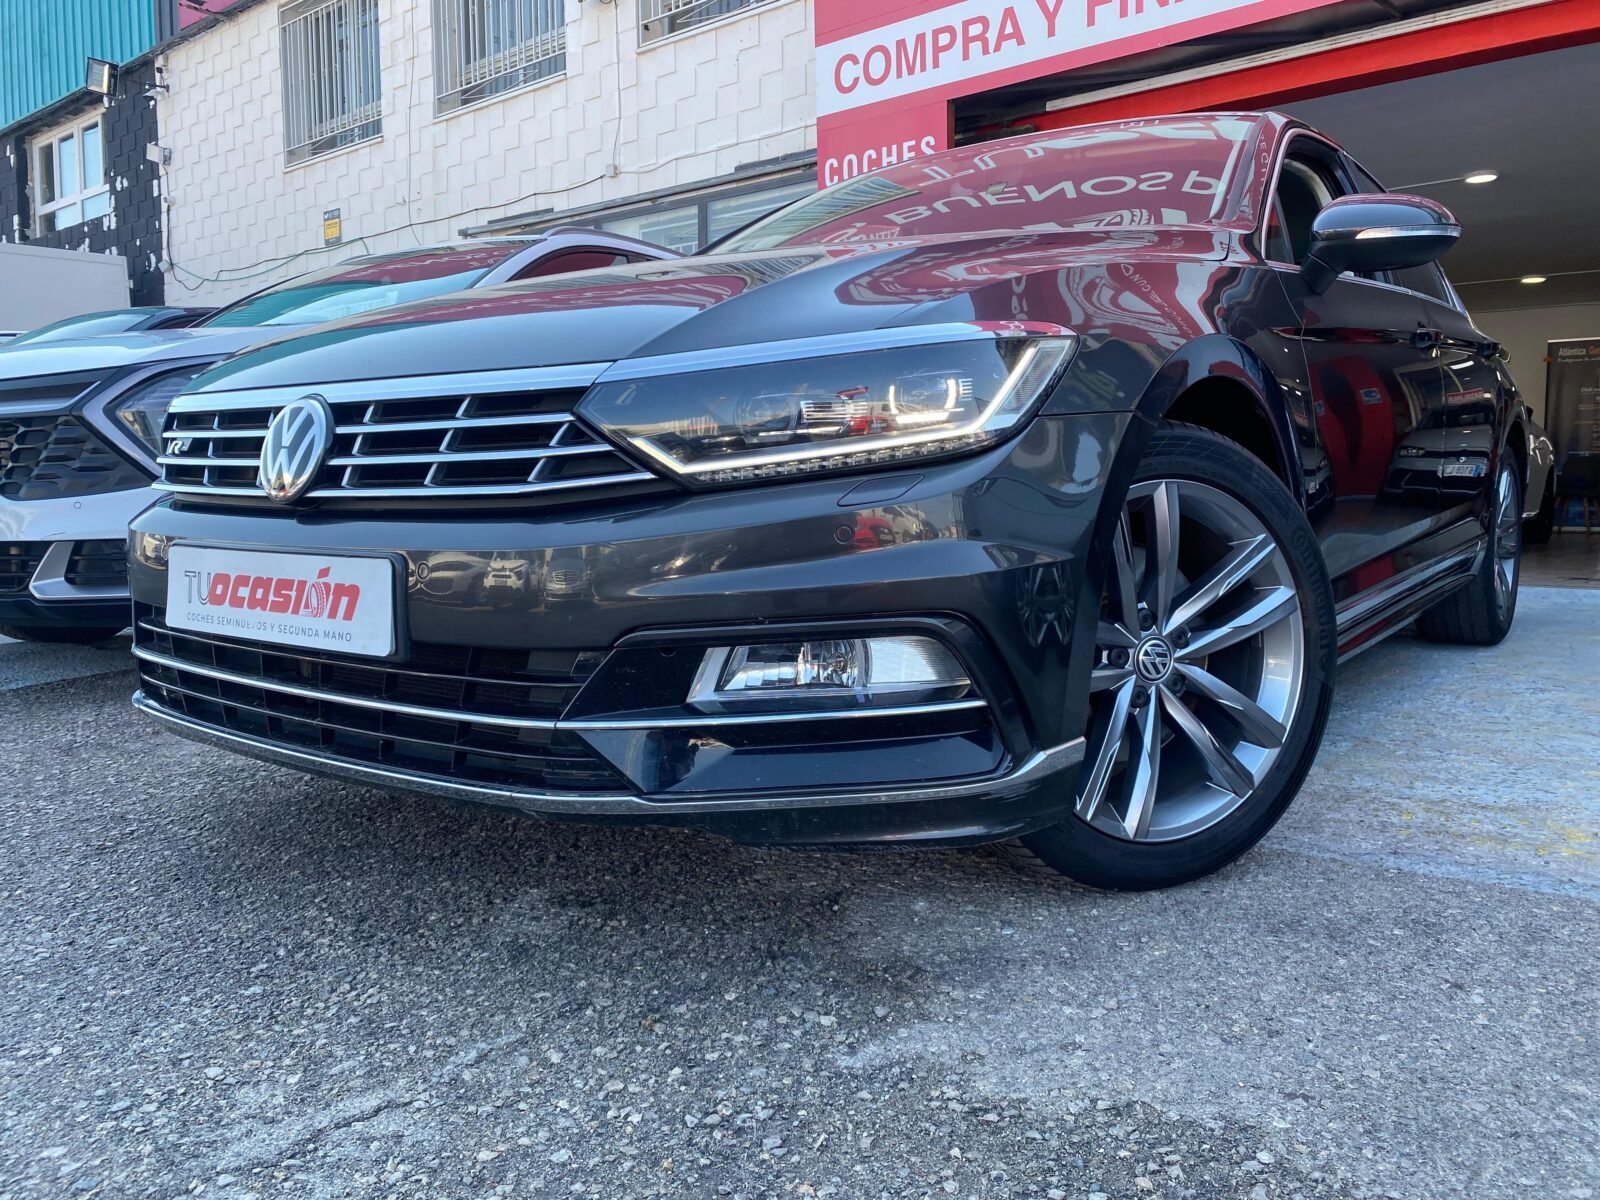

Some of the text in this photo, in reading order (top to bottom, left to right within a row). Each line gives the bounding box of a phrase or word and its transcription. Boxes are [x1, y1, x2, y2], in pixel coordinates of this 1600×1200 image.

[834, 6, 1026, 96] COMPRA
[1033, 0, 1063, 39] Y
[824, 135, 936, 188] COCHES
[186, 612, 352, 642] COCHES SEMINUEOS Y SEGUNDA MANO
